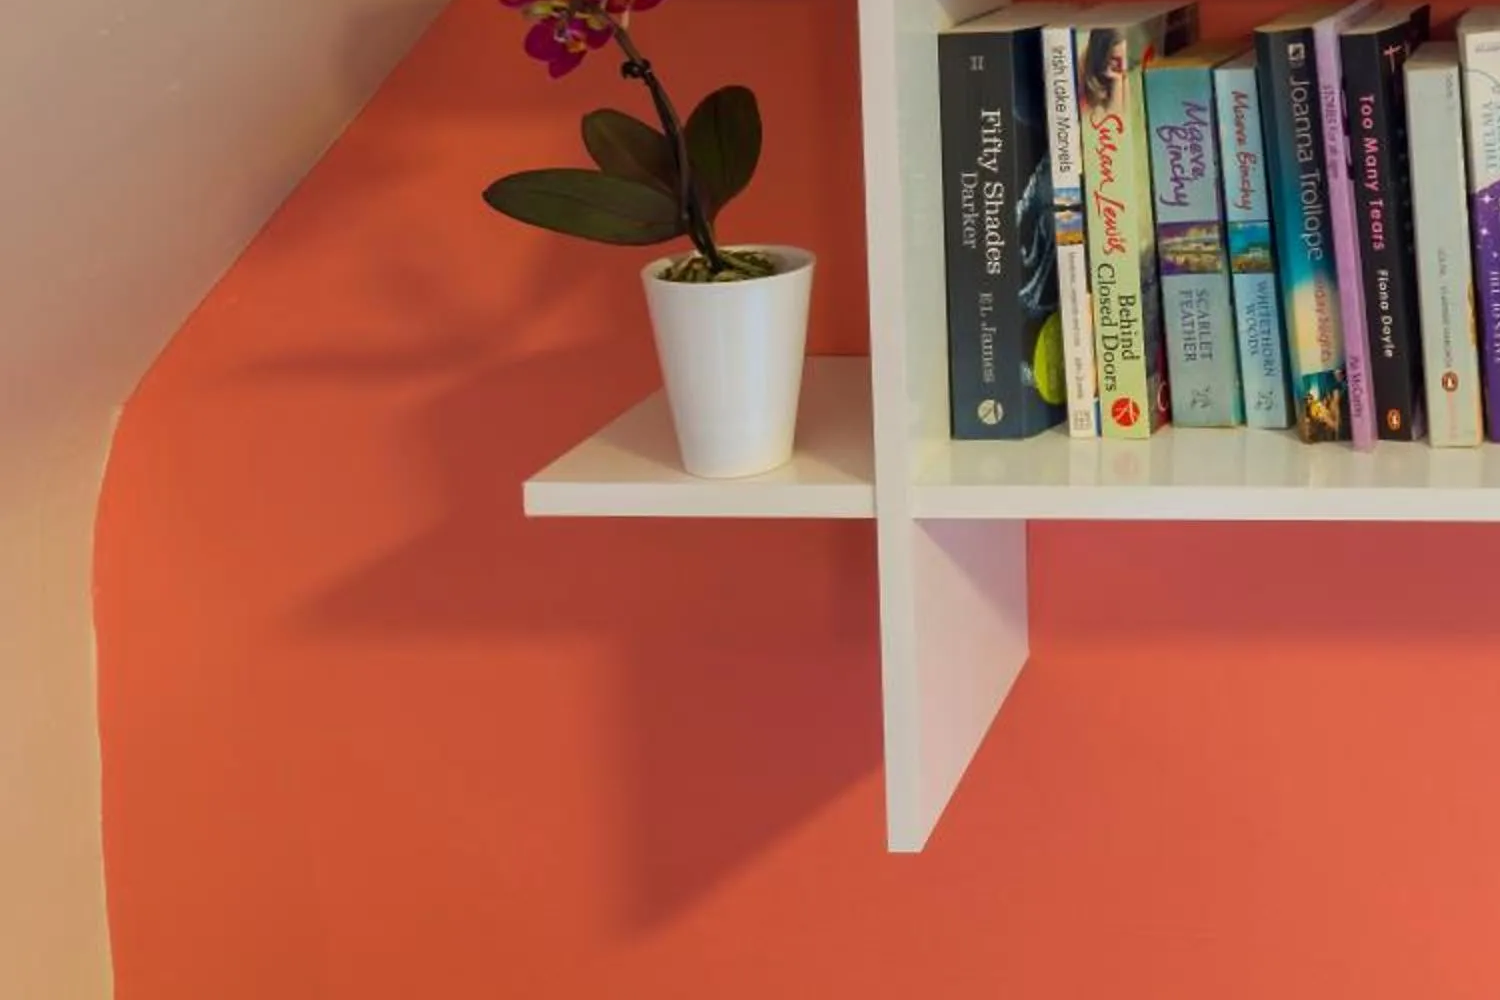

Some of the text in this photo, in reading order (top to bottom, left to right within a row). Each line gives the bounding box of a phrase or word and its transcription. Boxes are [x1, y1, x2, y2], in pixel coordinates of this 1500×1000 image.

[1051, 45, 1072, 174] Irish Lake Marvels
[1181, 100, 1209, 182] Maeve
[1230, 90, 1257, 211] Maeve Binchy
[961, 171, 979, 250] Darker
[977, 108, 1006, 275] Fifty Shades
[1089, 112, 1128, 256] Susan Lewis
[1155, 124, 1191, 208] Binchy
[1289, 74, 1325, 262] Joanna Trollope
[1359, 94, 1386, 251] Too Many Tears
[979, 321, 997, 384] James
[1096, 262, 1120, 392] Closed Doors
[1117, 294, 1141, 362] Behind
[1178, 288, 1198, 363] FEATHER
[1194, 287, 1214, 362] SCARLET
[1255, 279, 1276, 378] WHITETHORN
[1377, 268, 1398, 359] Fiona Doyle
